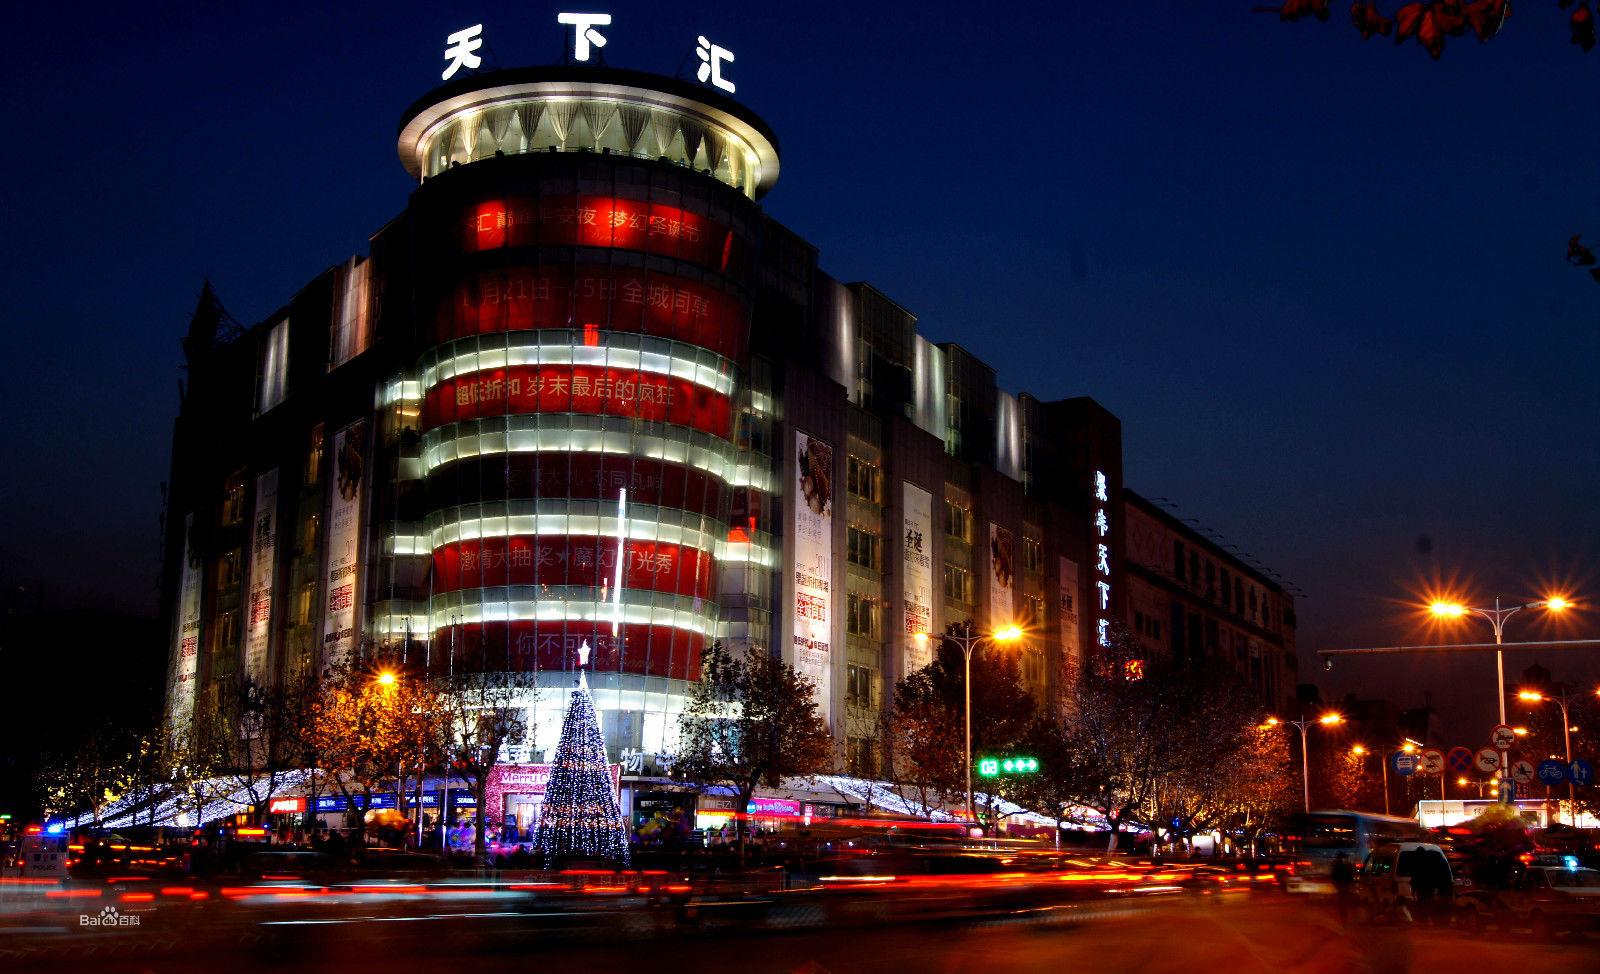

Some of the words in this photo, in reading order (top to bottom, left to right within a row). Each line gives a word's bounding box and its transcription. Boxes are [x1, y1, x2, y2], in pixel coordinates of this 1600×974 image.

[441, 12, 736, 94] 天下汇
[607, 209, 704, 242] 梦幻圣诞节
[455, 377, 521, 406] 超低折扣
[526, 374, 674, 406] 岁末最后的疯狂
[502, 773, 538, 783] Merry
